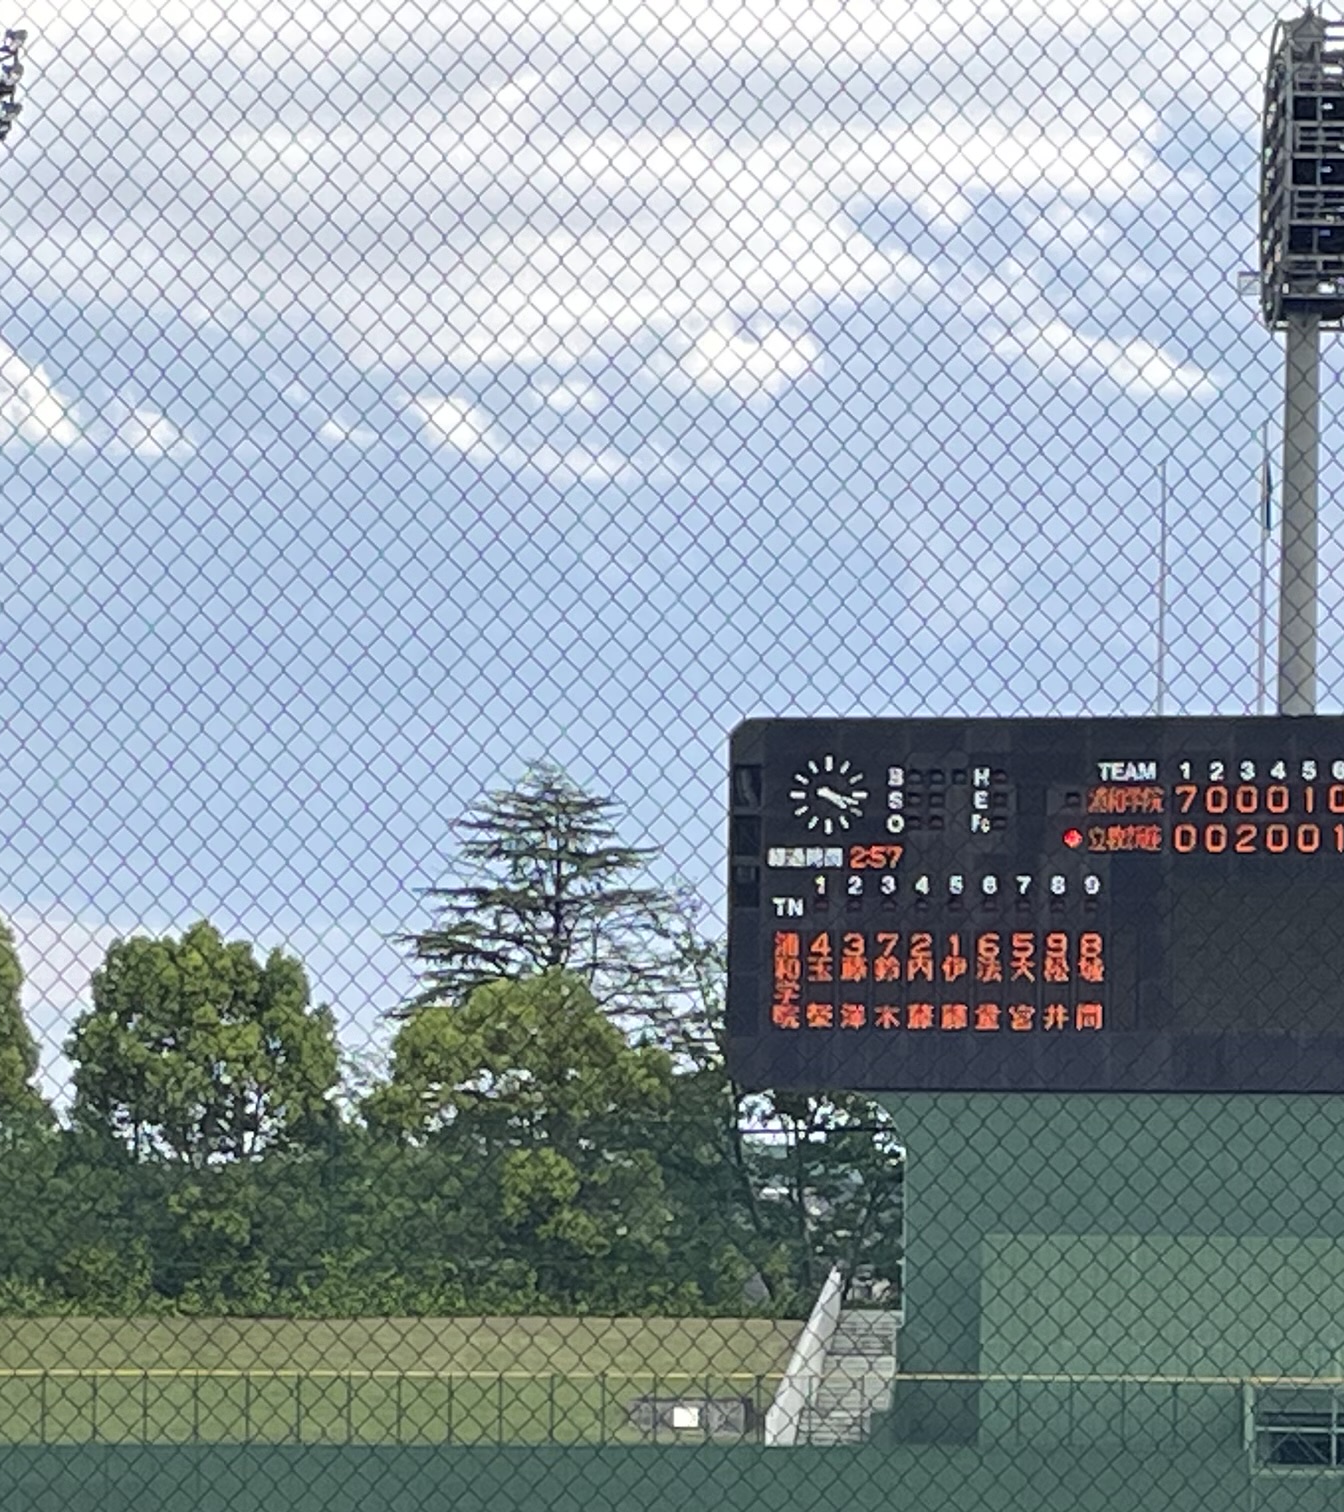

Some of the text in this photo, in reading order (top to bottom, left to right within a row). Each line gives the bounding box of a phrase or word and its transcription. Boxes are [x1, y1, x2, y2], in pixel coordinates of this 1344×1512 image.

[888, 768, 904, 786] B
[974, 768, 989, 786] H
[1098, 762, 1156, 781] TEAM
[1180, 762, 1190, 779] 1
[1210, 762, 1223, 781] 2
[1241, 761, 1255, 780] 3
[1271, 761, 1286, 779] 4
[1302, 761, 1316, 780] 5
[889, 791, 903, 809] S
[974, 791, 988, 809] E
[1176, 786, 1197, 812] 7
[1207, 786, 1227, 813] 0
[1237, 786, 1257, 812] 0
[1267, 786, 1288, 812] 0
[1306, 787, 1313, 812] 1
[887, 815, 904, 832] O
[1175, 825, 1196, 852] 0
[1206, 825, 1227, 852] 0
[1236, 825, 1257, 852] 2
[1267, 825, 1288, 852] 0
[1298, 824, 1319, 852] 0
[1335, 824, 1344, 852] 1
[816, 876, 1100, 894] 1 2 3 4 5 6 7 8 9
[773, 898, 803, 916] TN
[811, 933, 1102, 956] 4 3 7 2 1 6 5 9 8
